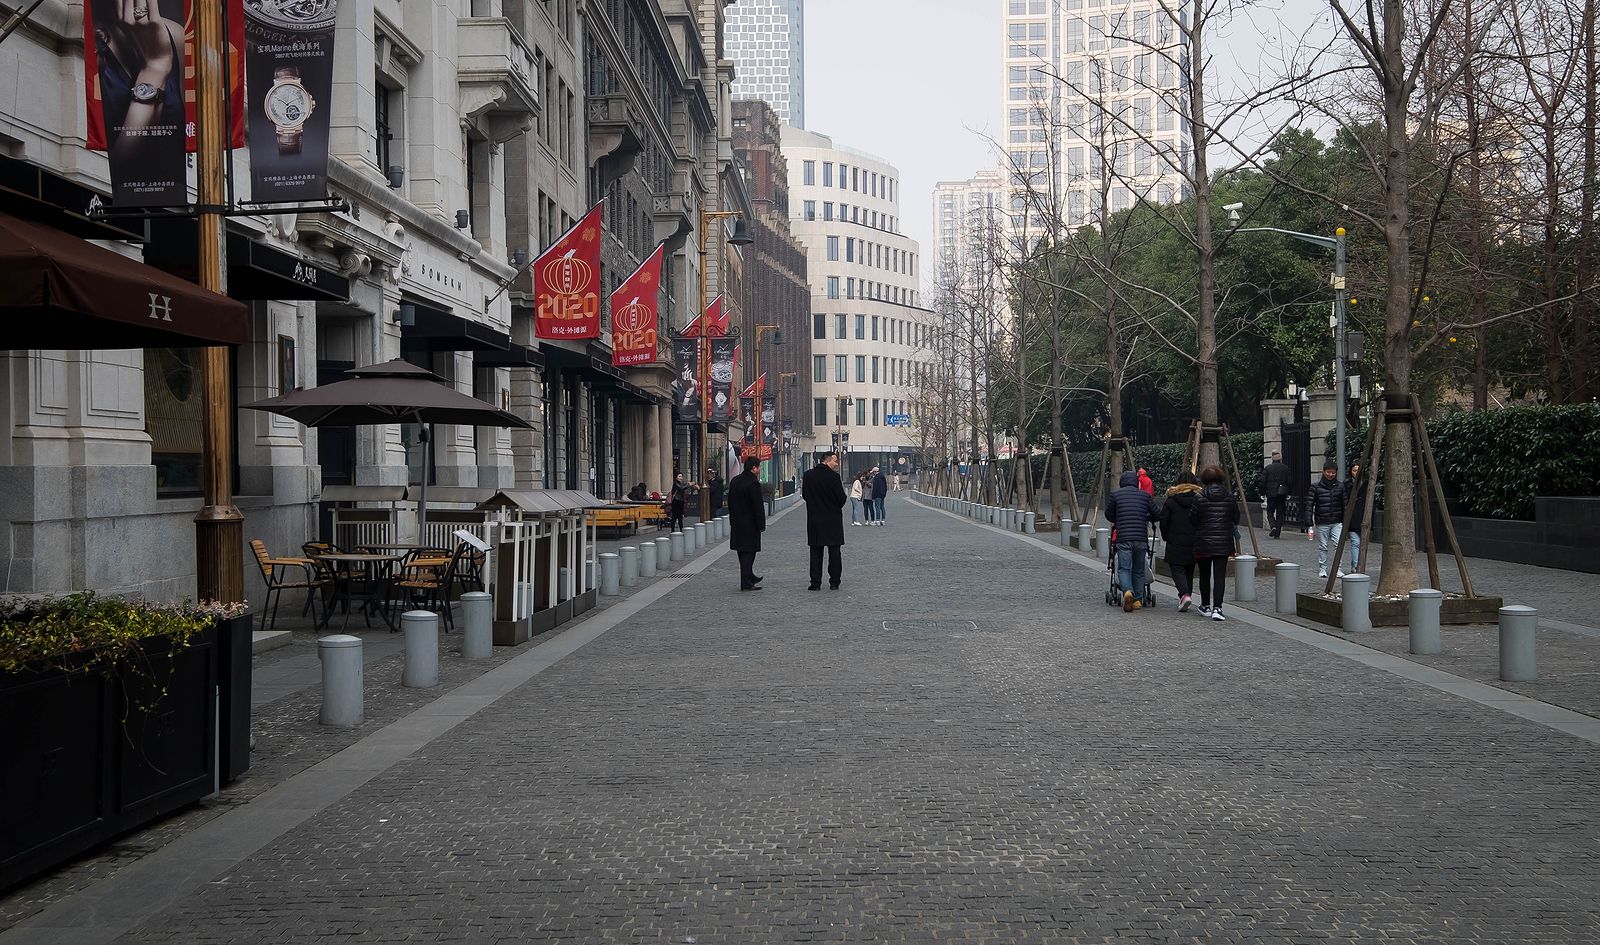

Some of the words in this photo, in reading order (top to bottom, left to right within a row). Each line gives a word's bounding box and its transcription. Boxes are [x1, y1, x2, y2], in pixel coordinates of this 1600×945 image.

[148, 292, 173, 322] H
[538, 292, 598, 320] 2020
[613, 328, 656, 351] 2020
